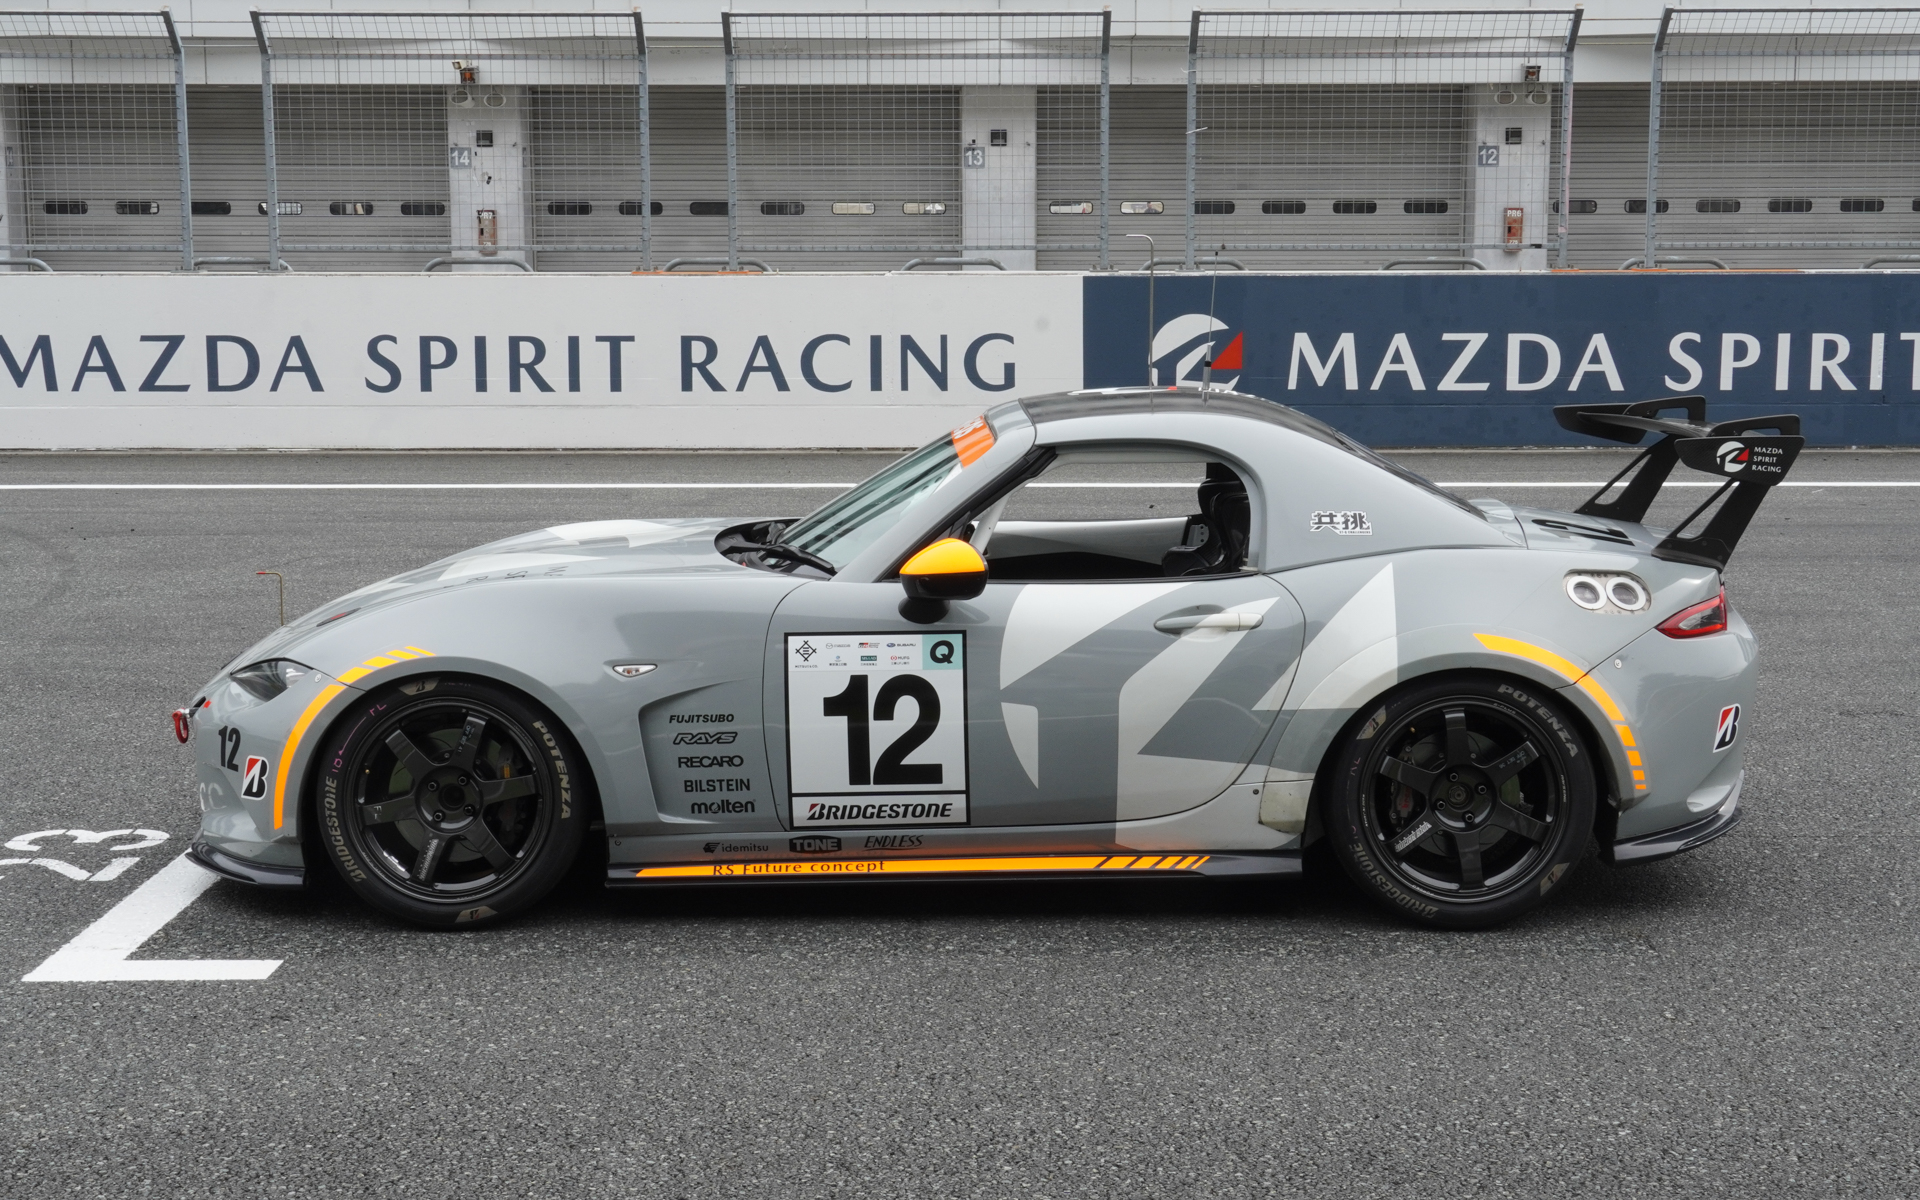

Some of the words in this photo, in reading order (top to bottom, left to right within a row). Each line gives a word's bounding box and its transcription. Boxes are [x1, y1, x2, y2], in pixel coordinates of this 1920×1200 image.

[452, 150, 470, 166] 14
[965, 149, 983, 166] 13
[1480, 149, 1498, 165] 12
[0, 334, 325, 393] MAZDA
[364, 333, 636, 394] SPIRIT
[680, 332, 1016, 394] RACING
[1287, 331, 1625, 392] MAZDA
[1753, 446, 1783, 455] MAZDA
[1753, 455, 1777, 463] SPIRIT
[1751, 464, 1782, 473] RACING
[929, 639, 955, 665] Q
[669, 713, 735, 724] FUJITSUBO
[1497, 683, 1579, 758] POTENZA
[823, 673, 943, 785] 12
[672, 731, 738, 745] RAYS
[218, 725, 242, 773] 12
[532, 720, 572, 820] POTENZA
[678, 755, 744, 769] RECARO
[683, 778, 751, 793] BILSTEIN
[691, 799, 756, 814] molten
[806, 802, 953, 821] BRIDGESTONE
[324, 775, 368, 884] BRIDGESTONE
[721, 843, 769, 852] idemitsu
[792, 838, 838, 851] TONE
[863, 834, 923, 848] ENDLESS
[713, 865, 734, 876] RS
[743, 861, 803, 875] Future
[810, 860, 886, 873] concept
[1348, 842, 1440, 919] BRIDGESTONE
